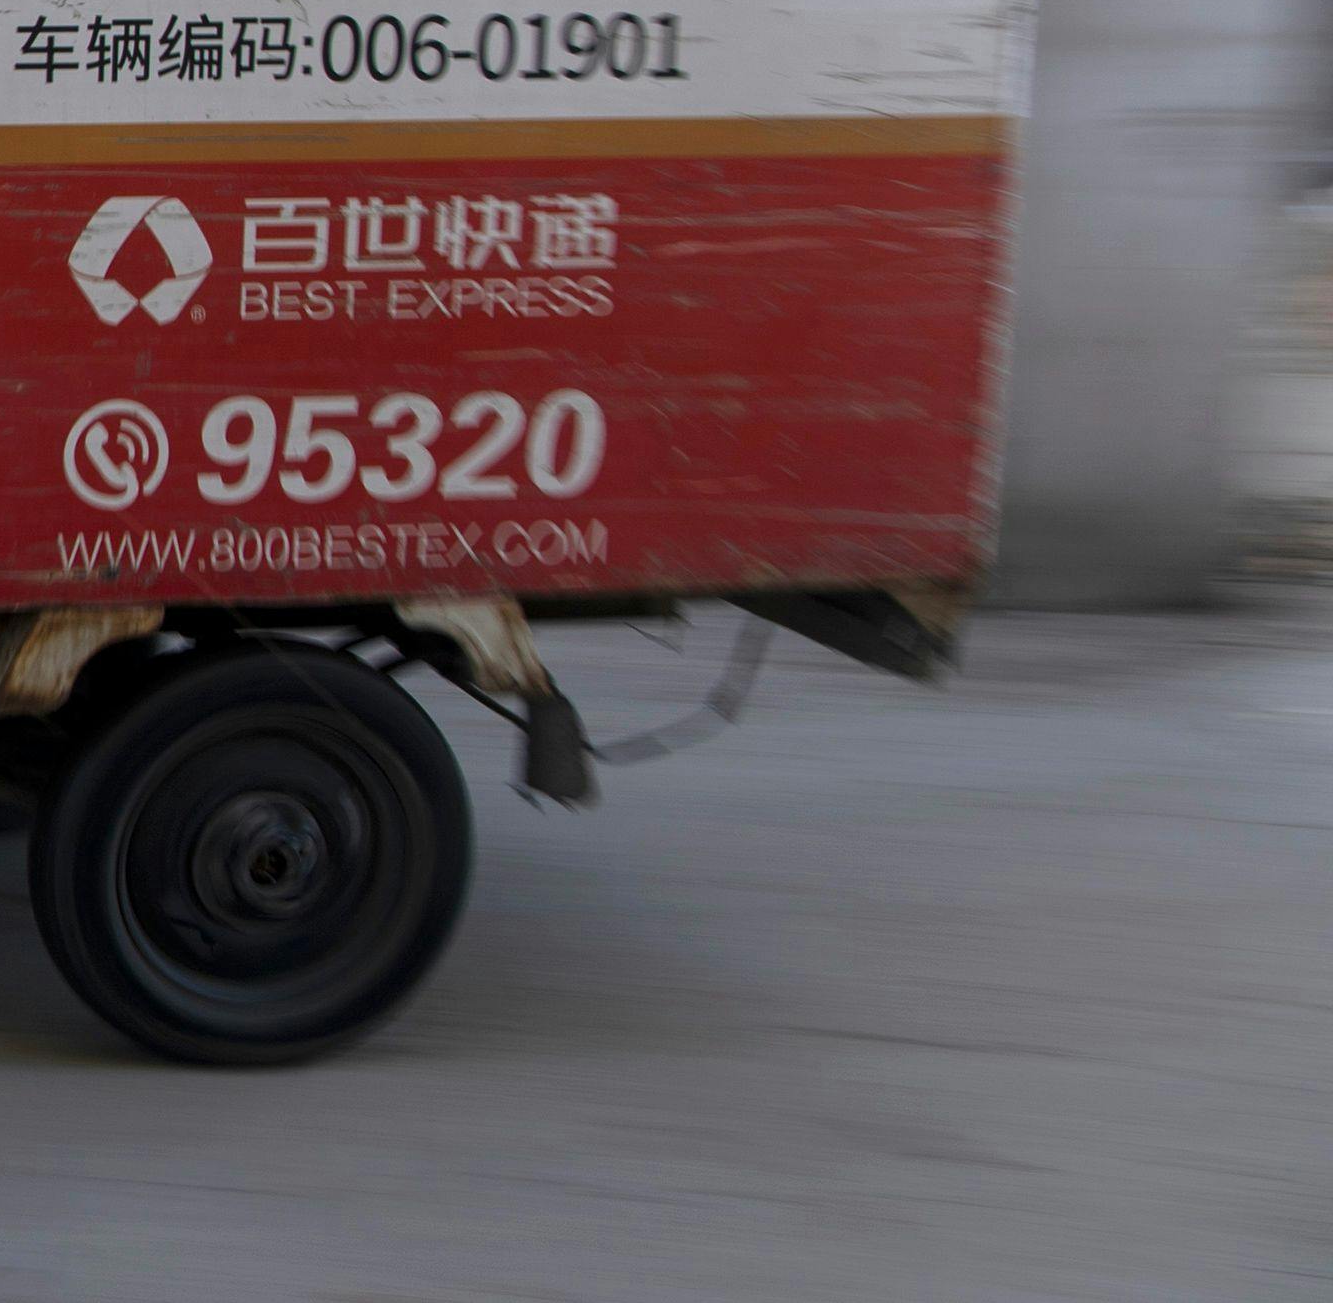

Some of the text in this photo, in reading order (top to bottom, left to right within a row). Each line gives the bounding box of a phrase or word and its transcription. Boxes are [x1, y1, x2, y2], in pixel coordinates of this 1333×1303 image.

[242, 193, 619, 273] 百世快递
[240, 275, 614, 321] BEST EXPRESS
[197, 388, 608, 505] 95320
[57, 518, 609, 574] WWW.800BESTEX.COM
